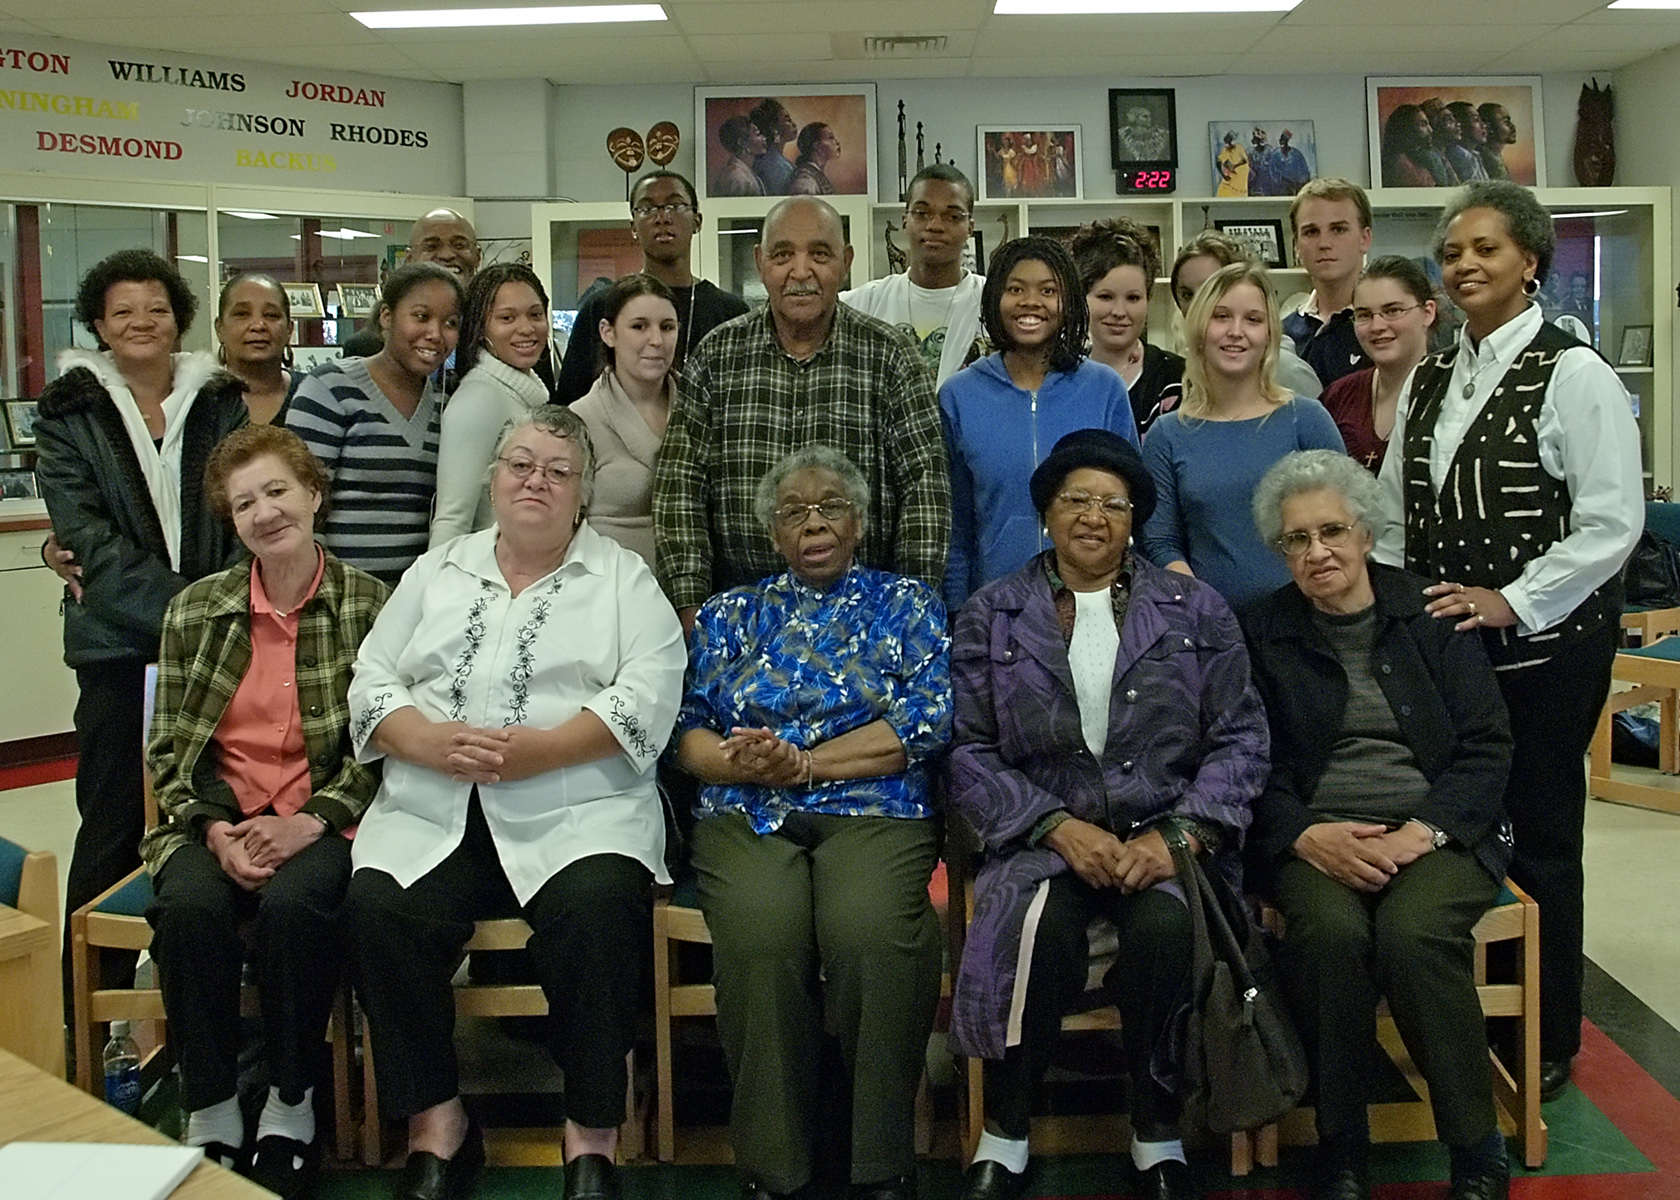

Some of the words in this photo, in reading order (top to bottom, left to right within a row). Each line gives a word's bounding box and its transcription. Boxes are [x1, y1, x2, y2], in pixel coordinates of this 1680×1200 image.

[108, 60, 246, 93] WILLIAMS
[285, 80, 386, 108] JORDAN
[180, 108, 306, 137] JOHNSON
[329, 123, 429, 149] RHODES
[36, 130, 183, 161] DESMOND
[235, 149, 337, 173] BACKUS
[1135, 170, 1170, 188] 2:22
